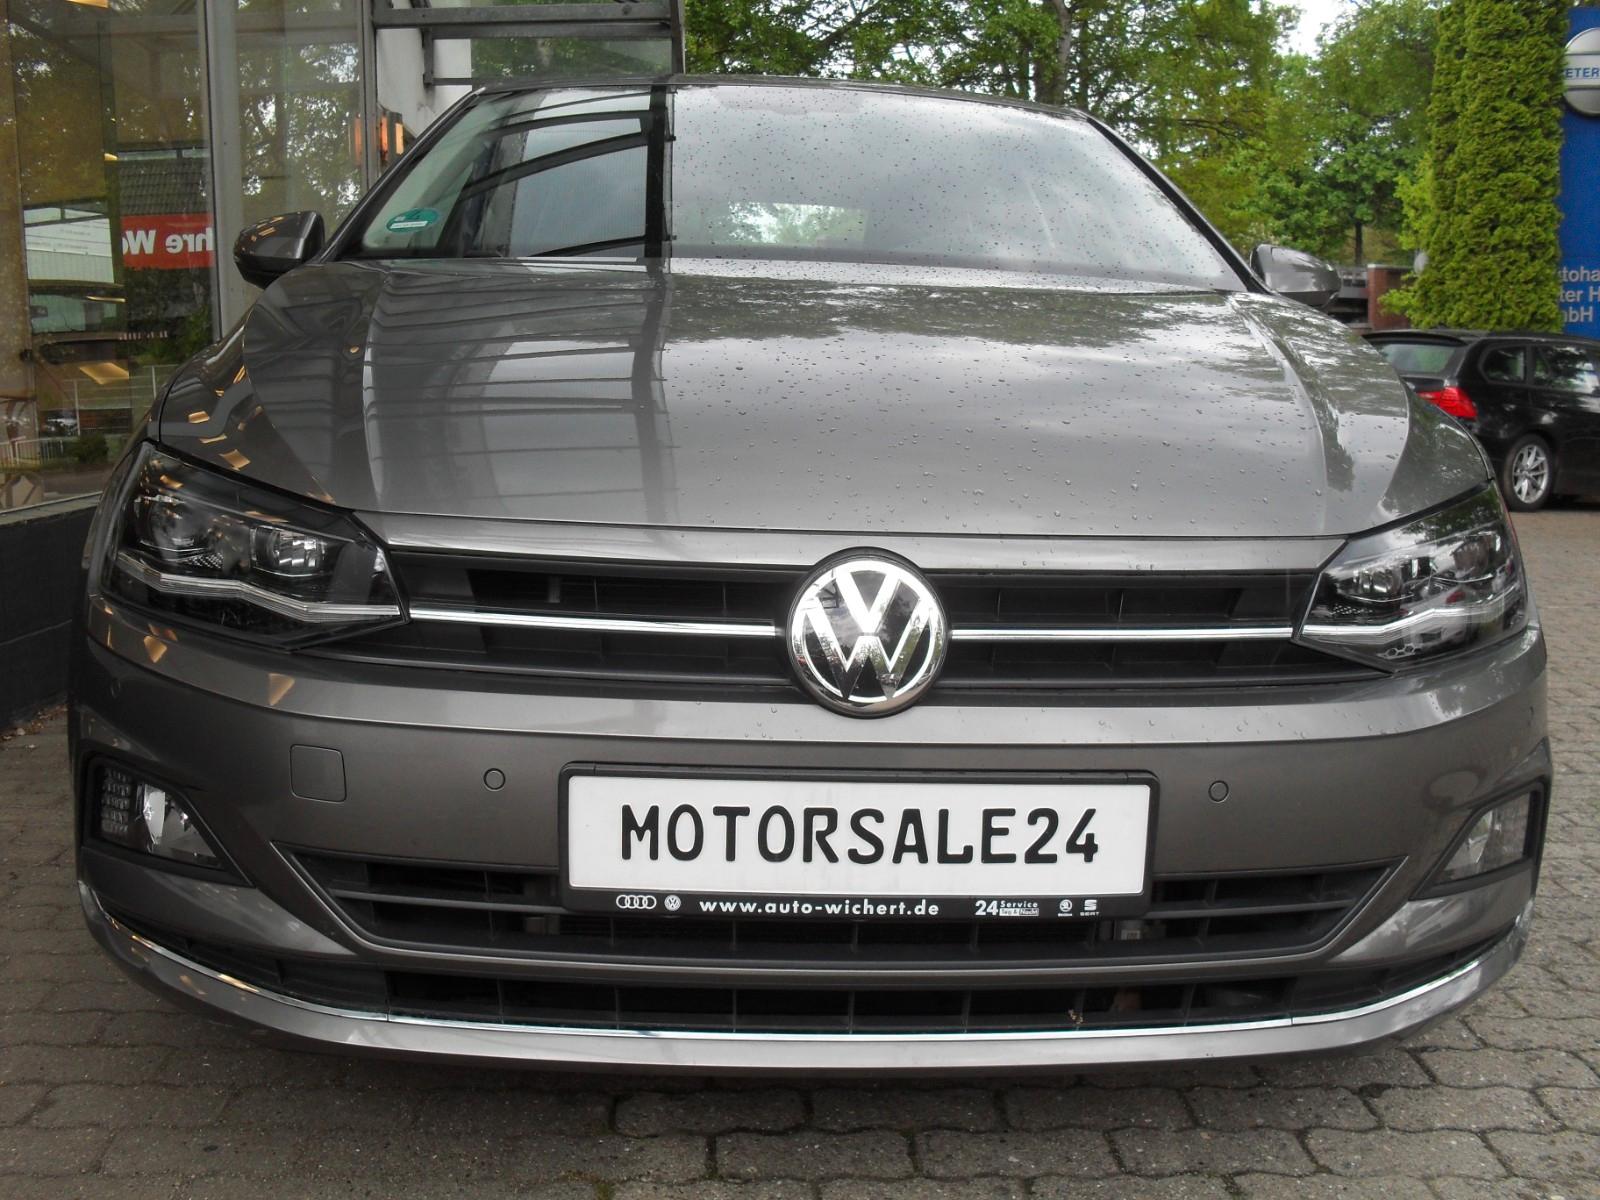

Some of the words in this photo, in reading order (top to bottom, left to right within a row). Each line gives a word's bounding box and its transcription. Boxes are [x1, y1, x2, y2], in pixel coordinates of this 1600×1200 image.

[1565, 67, 1600, 78] ETER
[620, 803, 1099, 865] MOTORSALE24
[699, 898, 939, 916] www.auto-wichert.de
[975, 900, 999, 916] 24
[1000, 900, 1038, 908] Service
